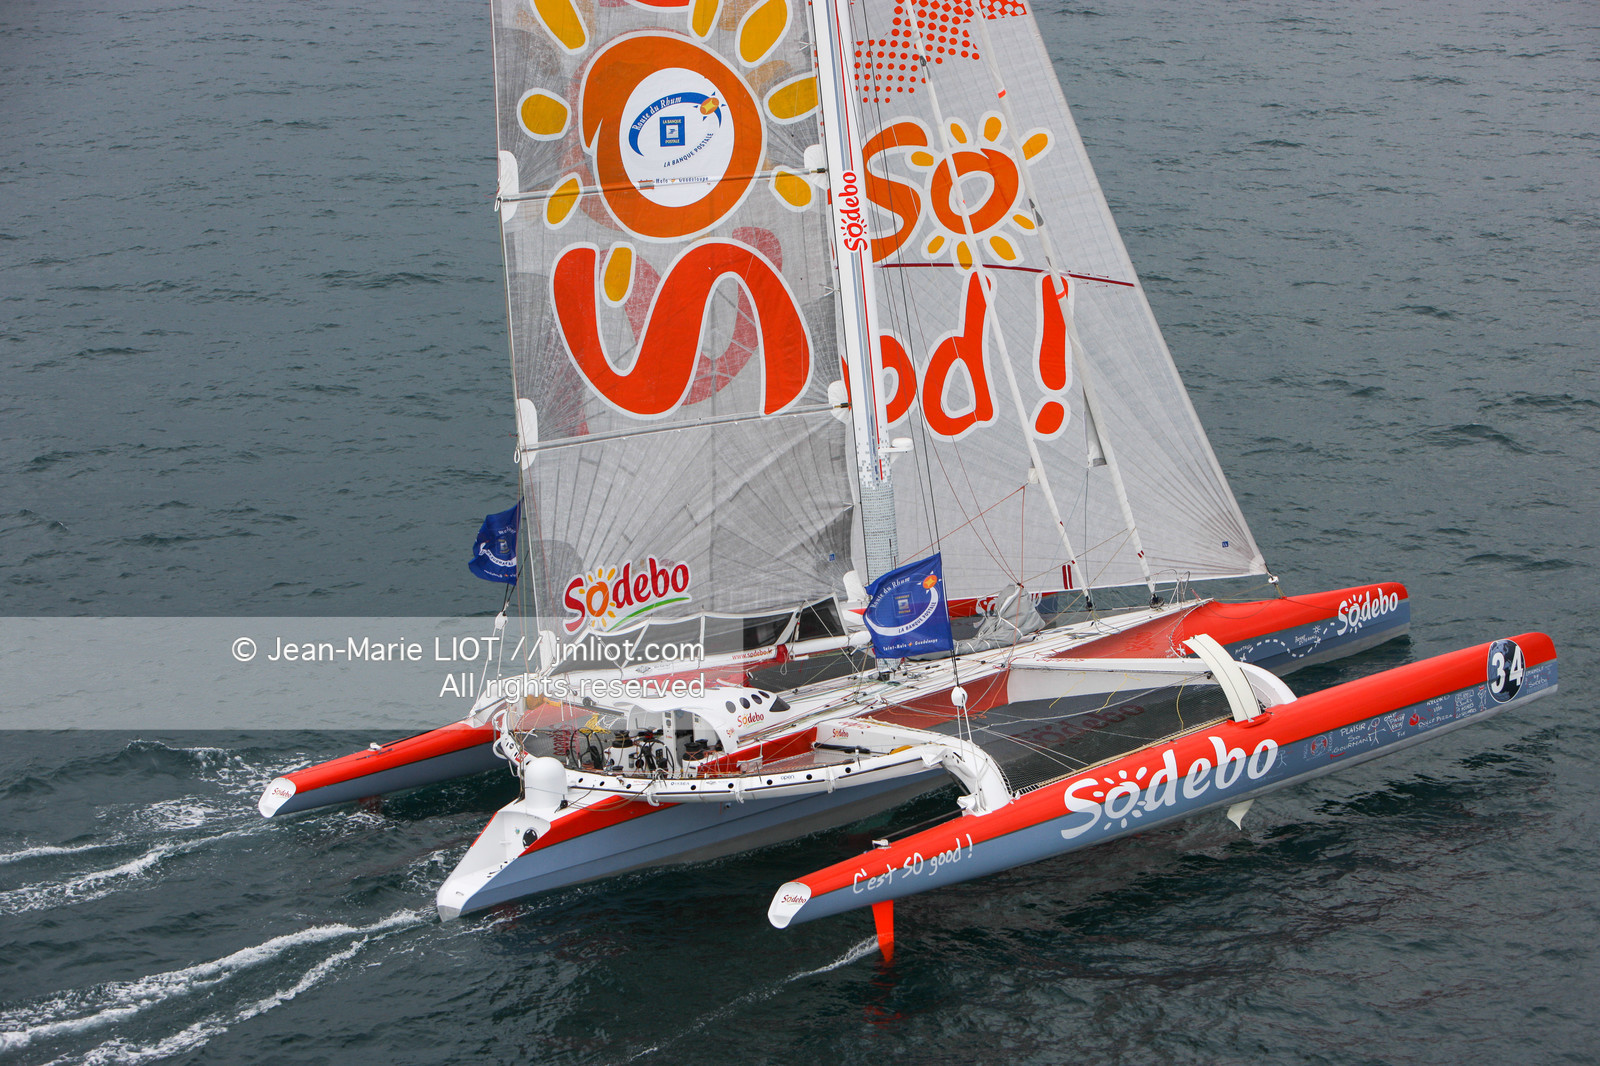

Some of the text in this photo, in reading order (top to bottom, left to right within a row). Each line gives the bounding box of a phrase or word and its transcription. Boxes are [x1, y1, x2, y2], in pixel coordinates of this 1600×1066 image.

[631, 96, 682, 131] Route du Rhum
[671, 151, 695, 166] BANQUE
[693, 133, 714, 153] POSTALE
[838, 171, 868, 252] Sodebo
[564, 557, 690, 632] Sodebo
[1337, 587, 1399, 636] Sodebo
[1490, 645, 1524, 694] 34
[737, 711, 765, 728] Sodebo
[1340, 722, 1366, 737] PLAISIR
[1060, 736, 1279, 840] Sodebo
[852, 863, 898, 895] C'est
[901, 852, 924, 879] SO
[928, 837, 961, 876] good
[781, 894, 807, 904] Sodebo
